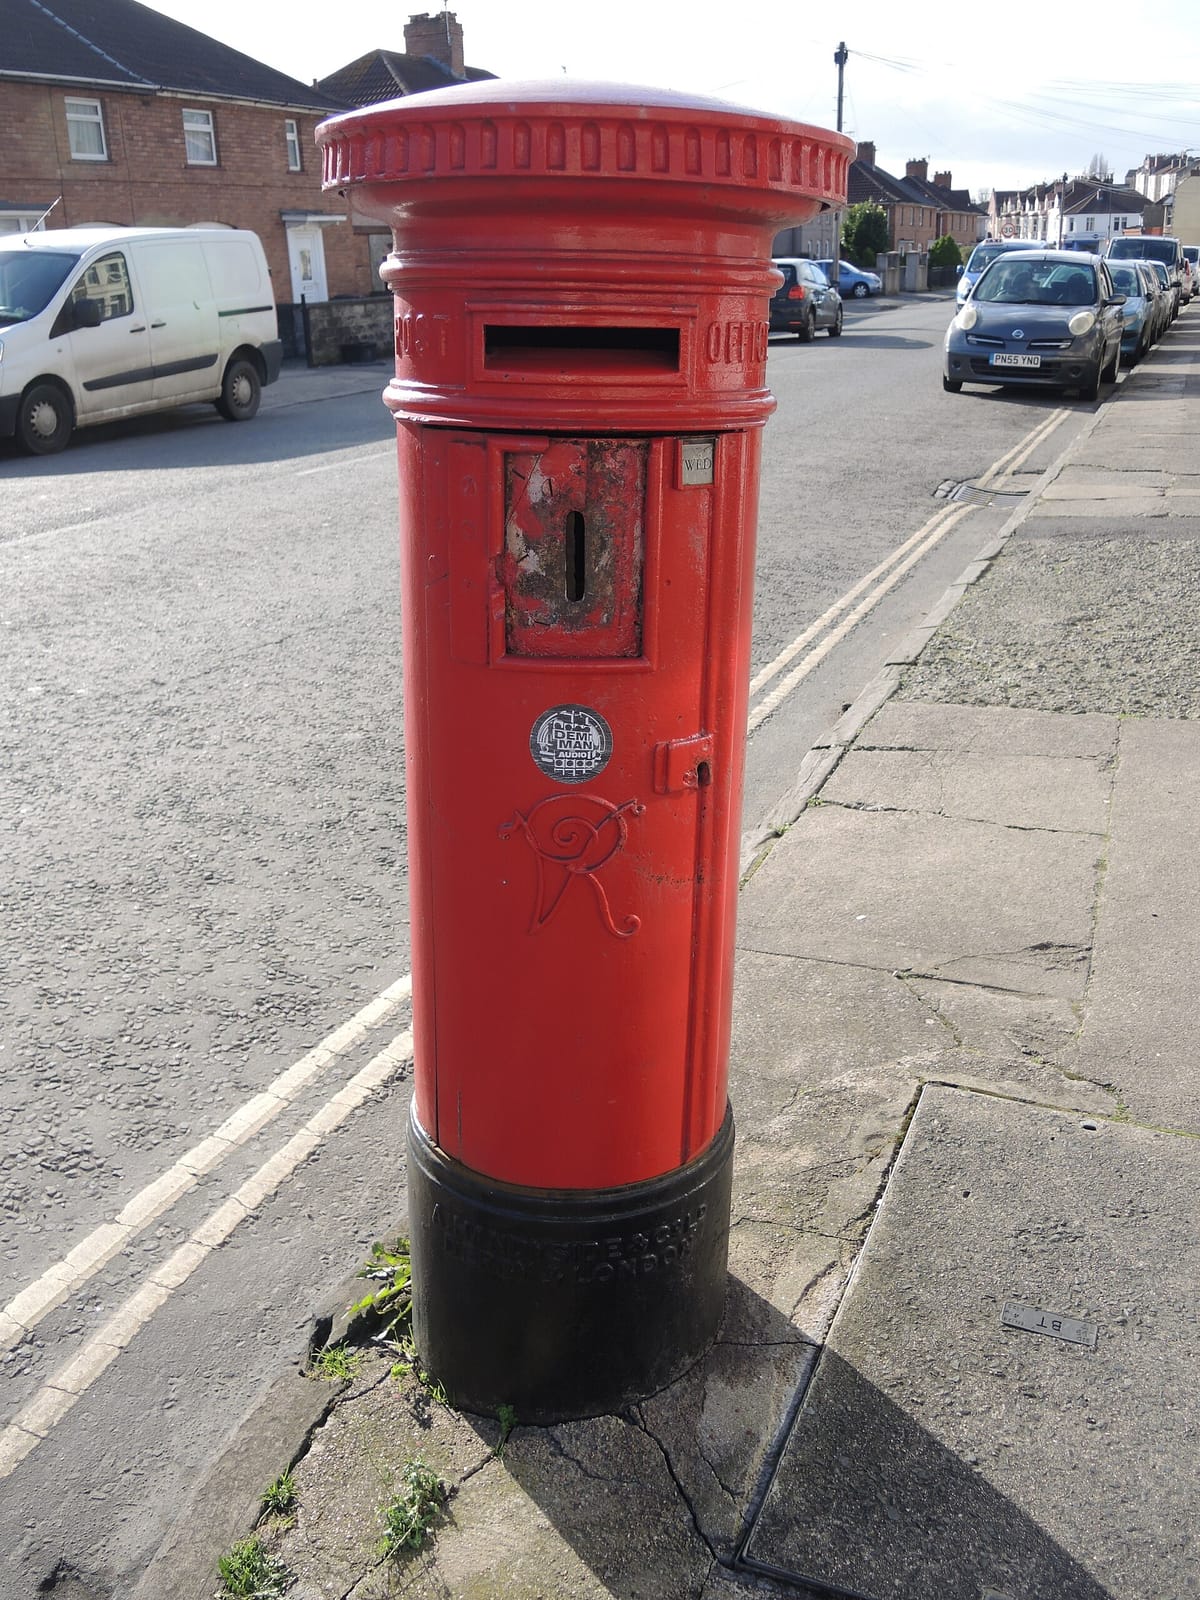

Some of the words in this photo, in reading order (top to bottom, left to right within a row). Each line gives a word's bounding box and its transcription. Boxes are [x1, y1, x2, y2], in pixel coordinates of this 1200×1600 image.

[707, 321, 769, 363] OFFIC
[994, 354, 1019, 365] PN55
[554, 729, 588, 741] DEM
[559, 739, 593, 749] MAN
[1036, 1316, 1062, 1332] BT
